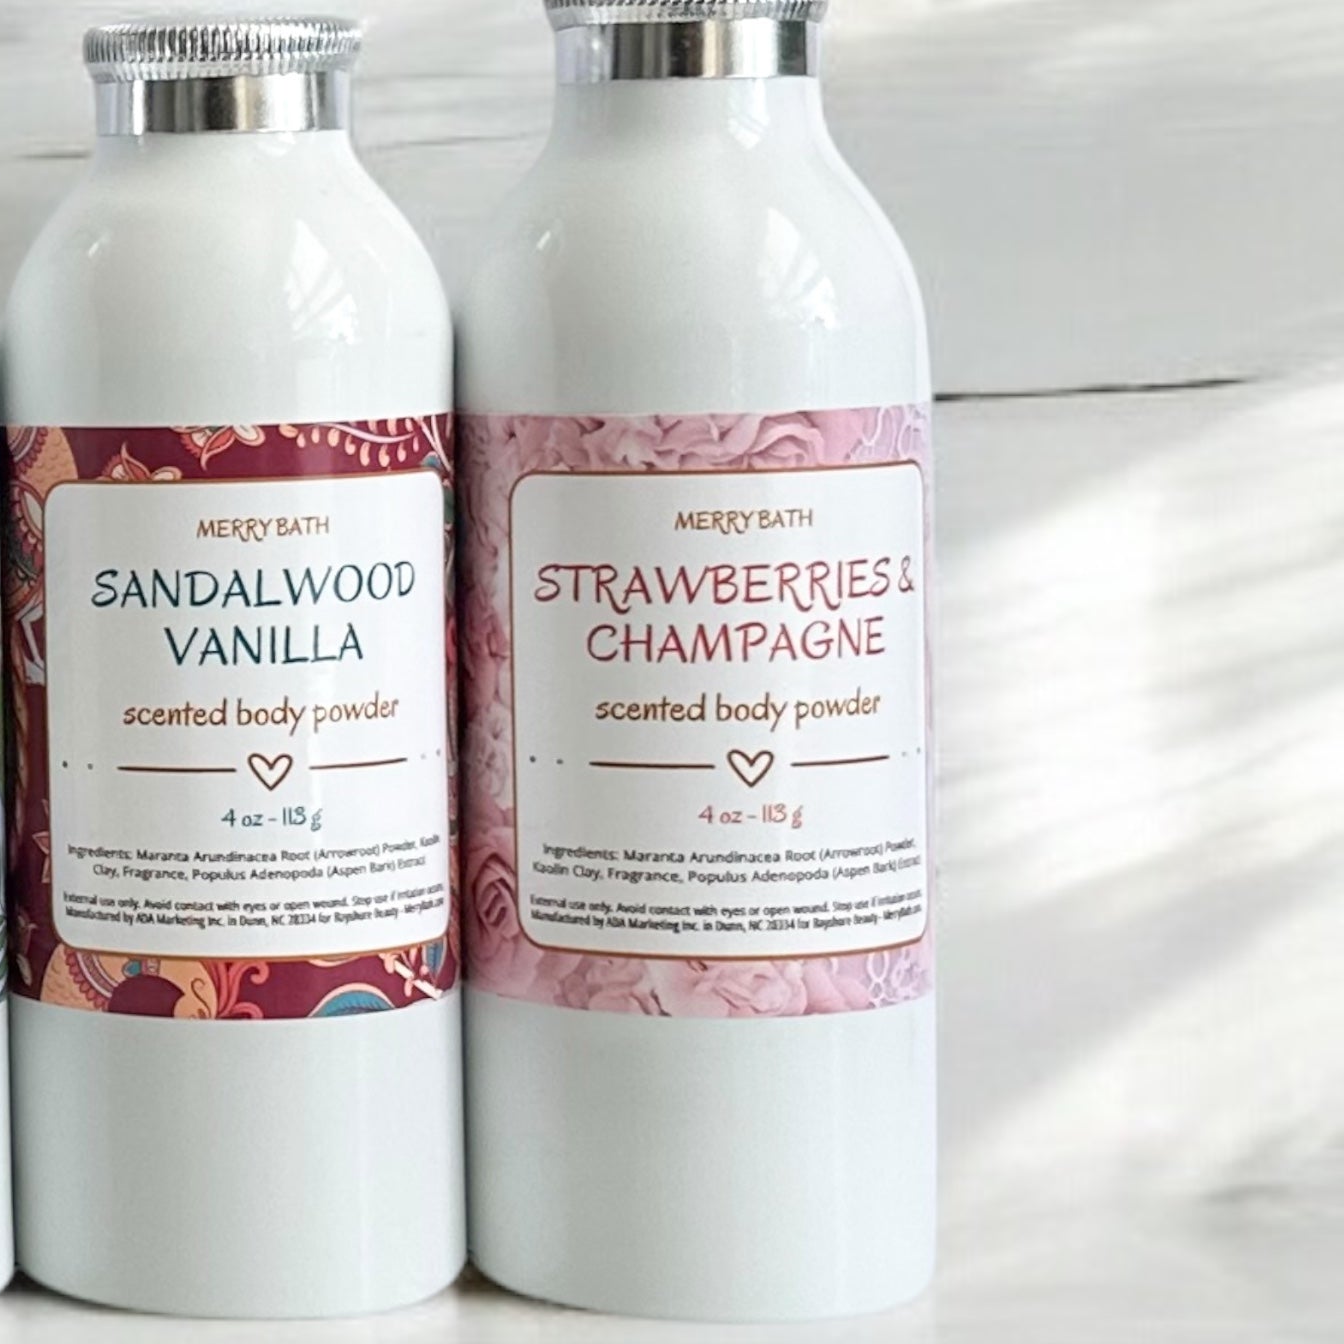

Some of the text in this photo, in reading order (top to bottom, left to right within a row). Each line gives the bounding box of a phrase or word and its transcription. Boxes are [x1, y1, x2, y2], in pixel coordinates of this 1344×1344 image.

[197, 517, 329, 542] MERRY BATH
[675, 509, 813, 535] MERRY BATH
[91, 561, 415, 608] SANDALWOOD
[534, 555, 914, 615] STRAWBERRIES &
[164, 623, 363, 665] VANILLA
[587, 616, 885, 664] CHAMPAGNE
[123, 691, 399, 736] scented body powder
[596, 687, 880, 732] scented body powder
[221, 809, 236, 827] 4
[242, 814, 263, 827] oz
[283, 806, 307, 826] 113
[310, 808, 323, 832] g
[698, 805, 713, 824] 4
[720, 811, 742, 824] oz
[762, 803, 788, 823] 113
[791, 805, 803, 829] g
